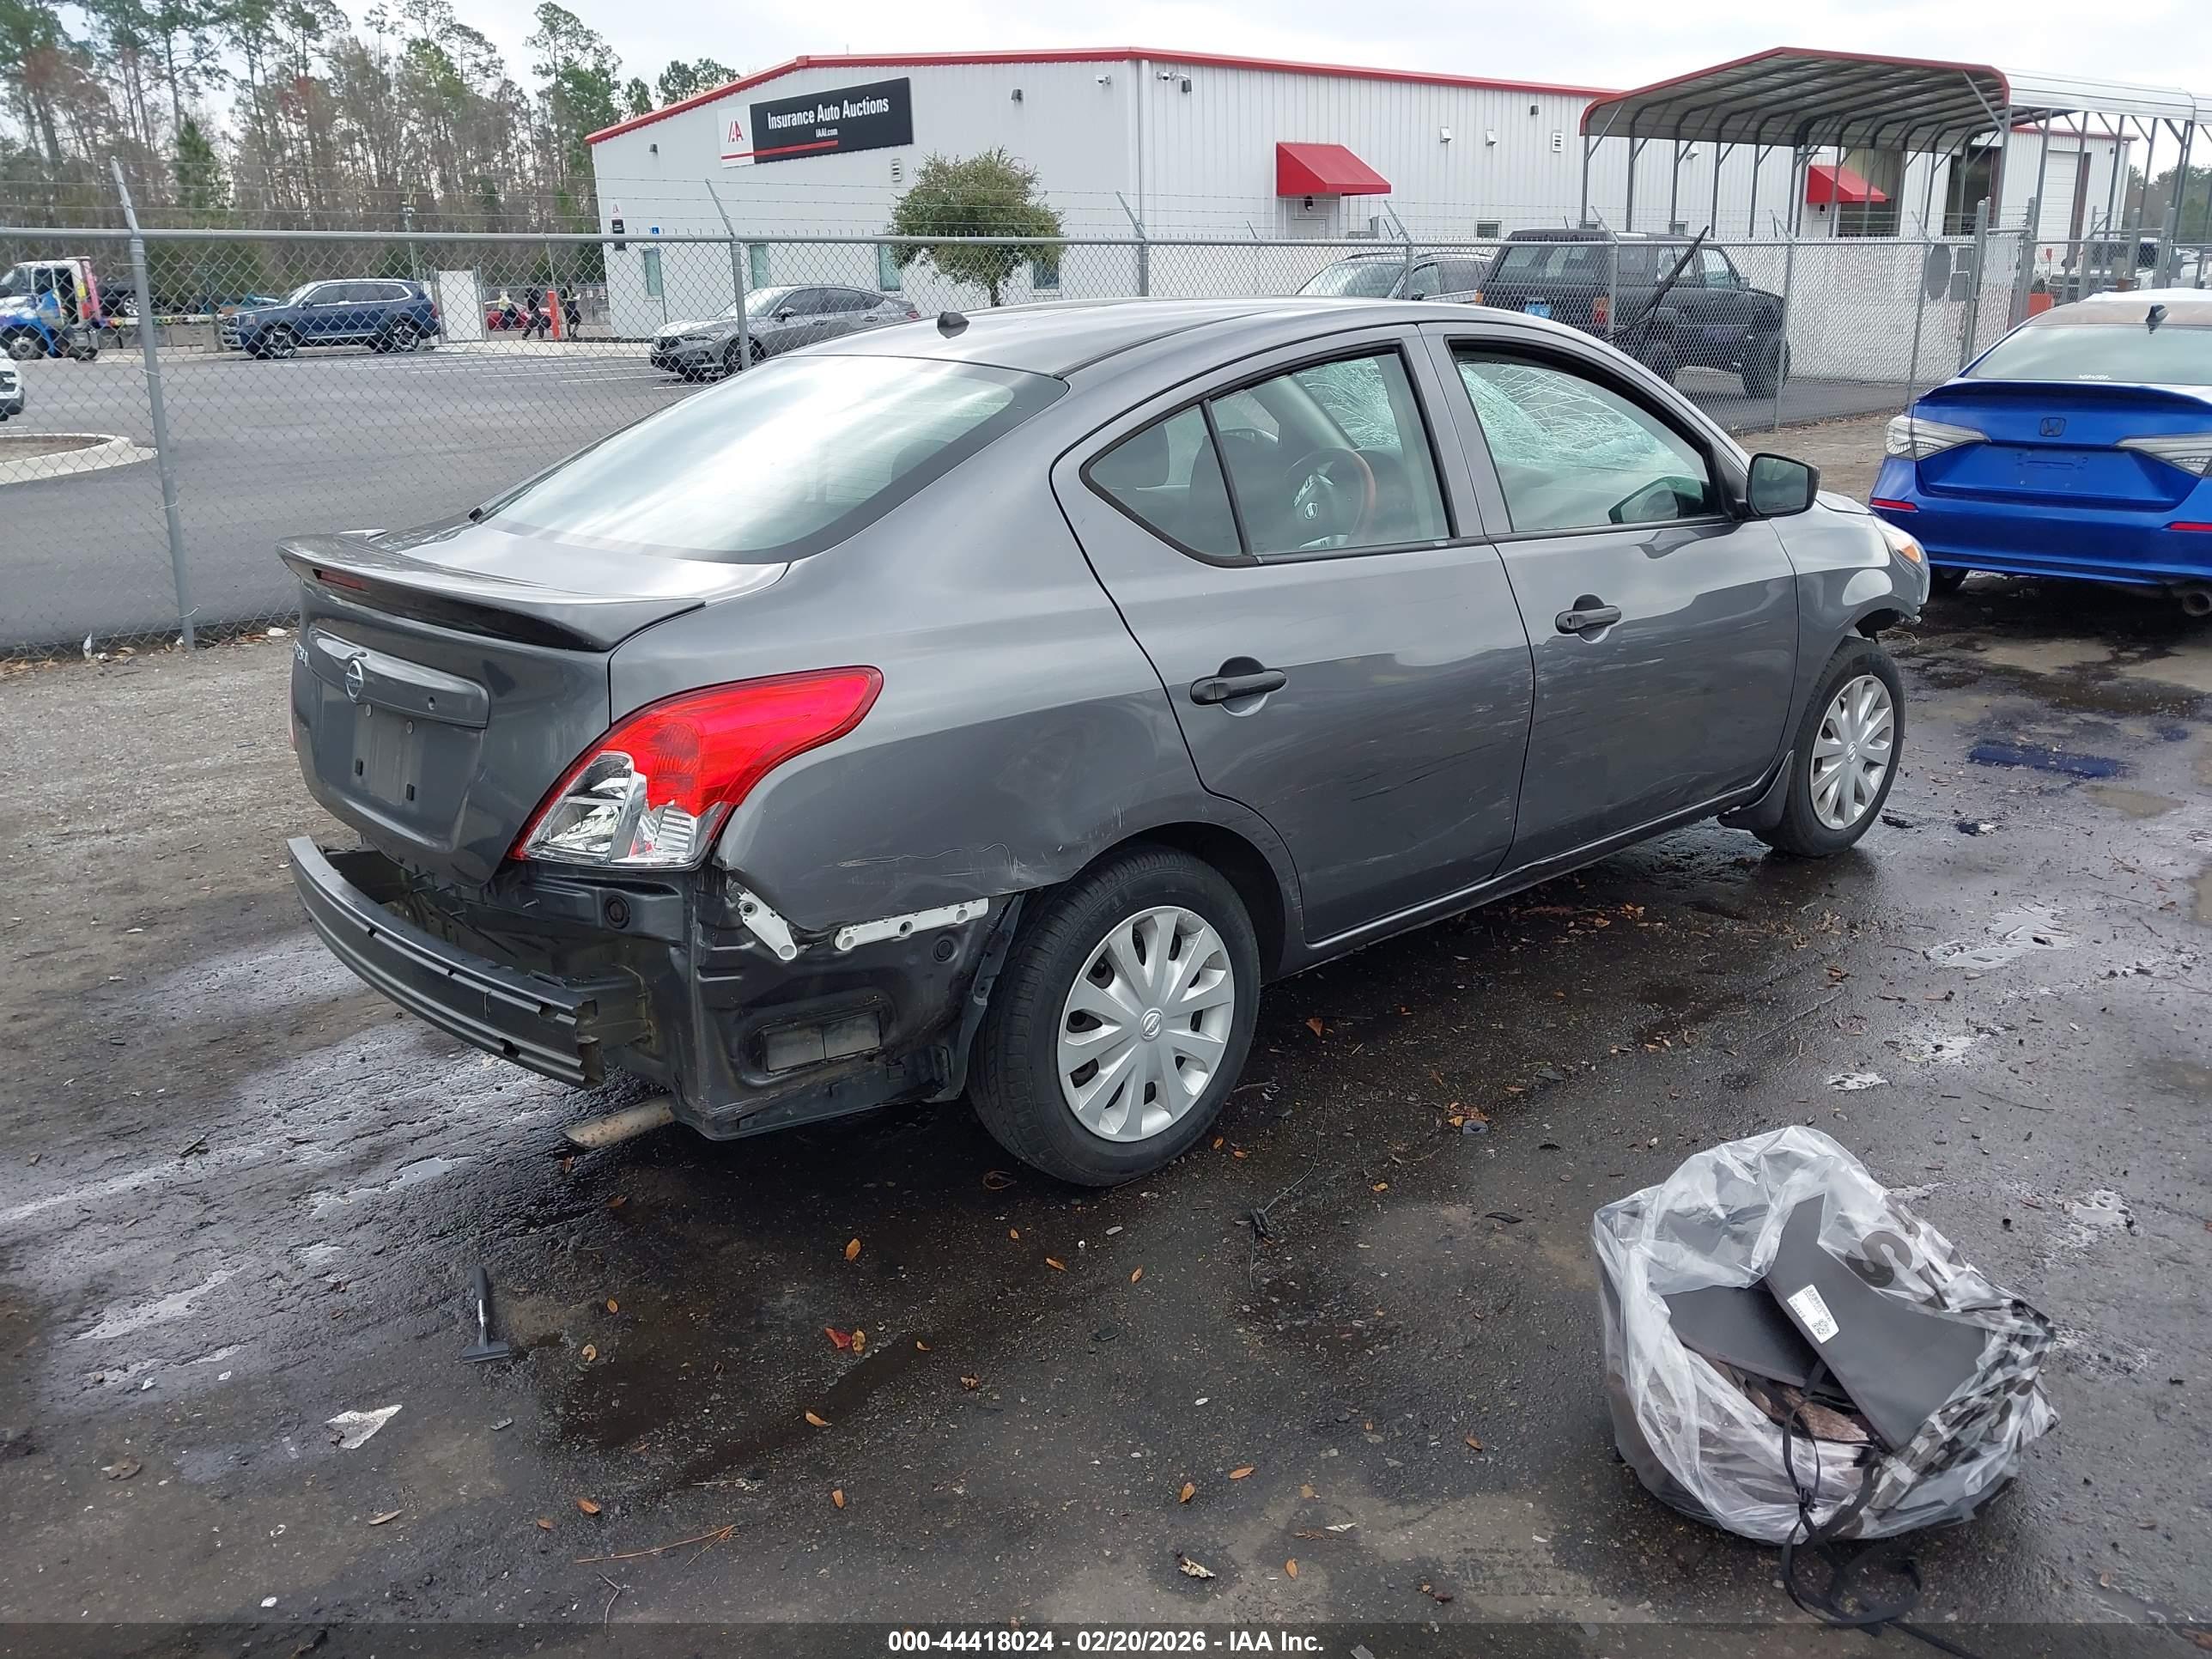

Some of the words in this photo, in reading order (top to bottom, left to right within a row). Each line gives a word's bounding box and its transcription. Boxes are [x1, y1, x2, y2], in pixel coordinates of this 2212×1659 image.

[767, 110, 815, 130] Insurance
[817, 103, 841, 123] Auto
[842, 95, 890, 118] Auctions
